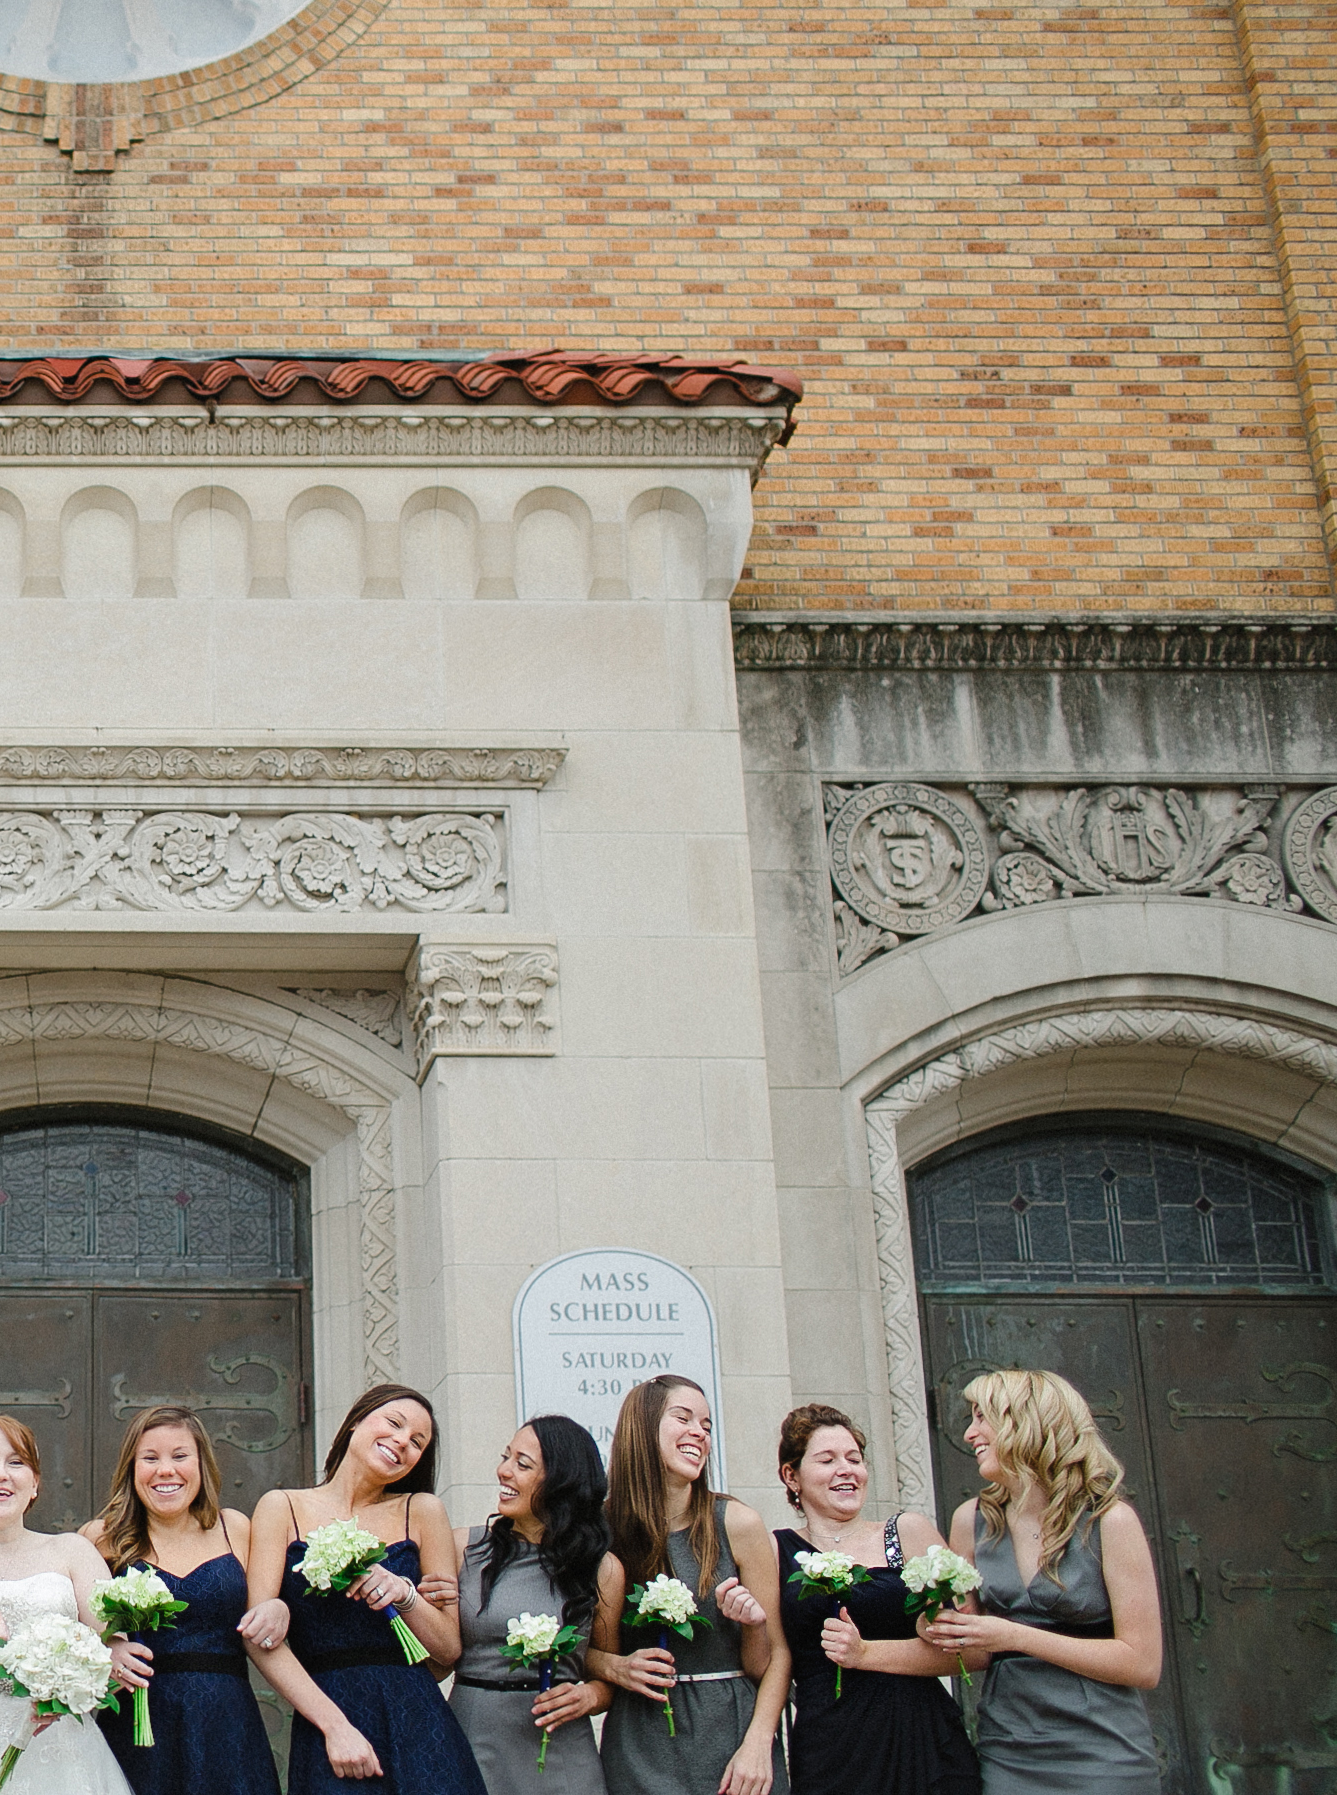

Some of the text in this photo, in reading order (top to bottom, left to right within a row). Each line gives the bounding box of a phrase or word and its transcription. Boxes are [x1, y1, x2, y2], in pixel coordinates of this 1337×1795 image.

[580, 1272, 649, 1292] MASS
[550, 1302, 680, 1322] SCHEDULE
[562, 1352, 674, 1369] SATURDAY
[577, 1379, 622, 1396] 4:30
